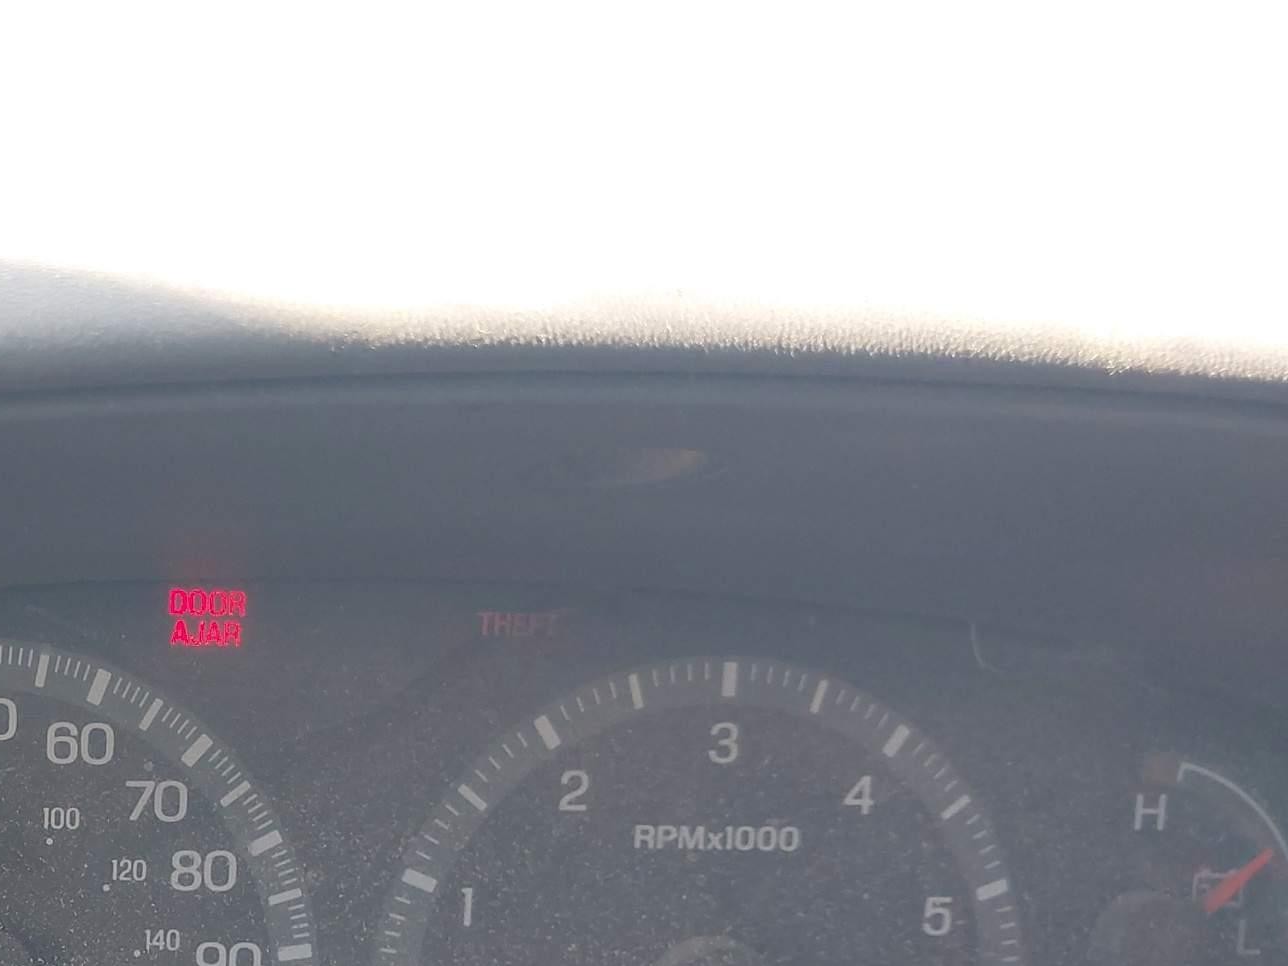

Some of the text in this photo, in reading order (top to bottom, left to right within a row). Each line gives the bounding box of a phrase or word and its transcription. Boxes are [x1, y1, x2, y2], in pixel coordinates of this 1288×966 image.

[169, 589, 247, 616] DOOR
[169, 620, 242, 647] AJAR
[477, 612, 561, 637] THEFT
[46, 721, 114, 765] 60
[708, 722, 739, 764] 3
[125, 780, 188, 822] 70
[559, 770, 590, 811] 2
[844, 776, 874, 814] 4
[43, 807, 80, 830] 100
[1134, 794, 1167, 831] H
[112, 859, 146, 881] 120
[171, 850, 237, 892] 80
[461, 887, 473, 927] 1
[922, 897, 952, 936] 5
[145, 928, 180, 952] 140
[1237, 919, 1261, 955] L
